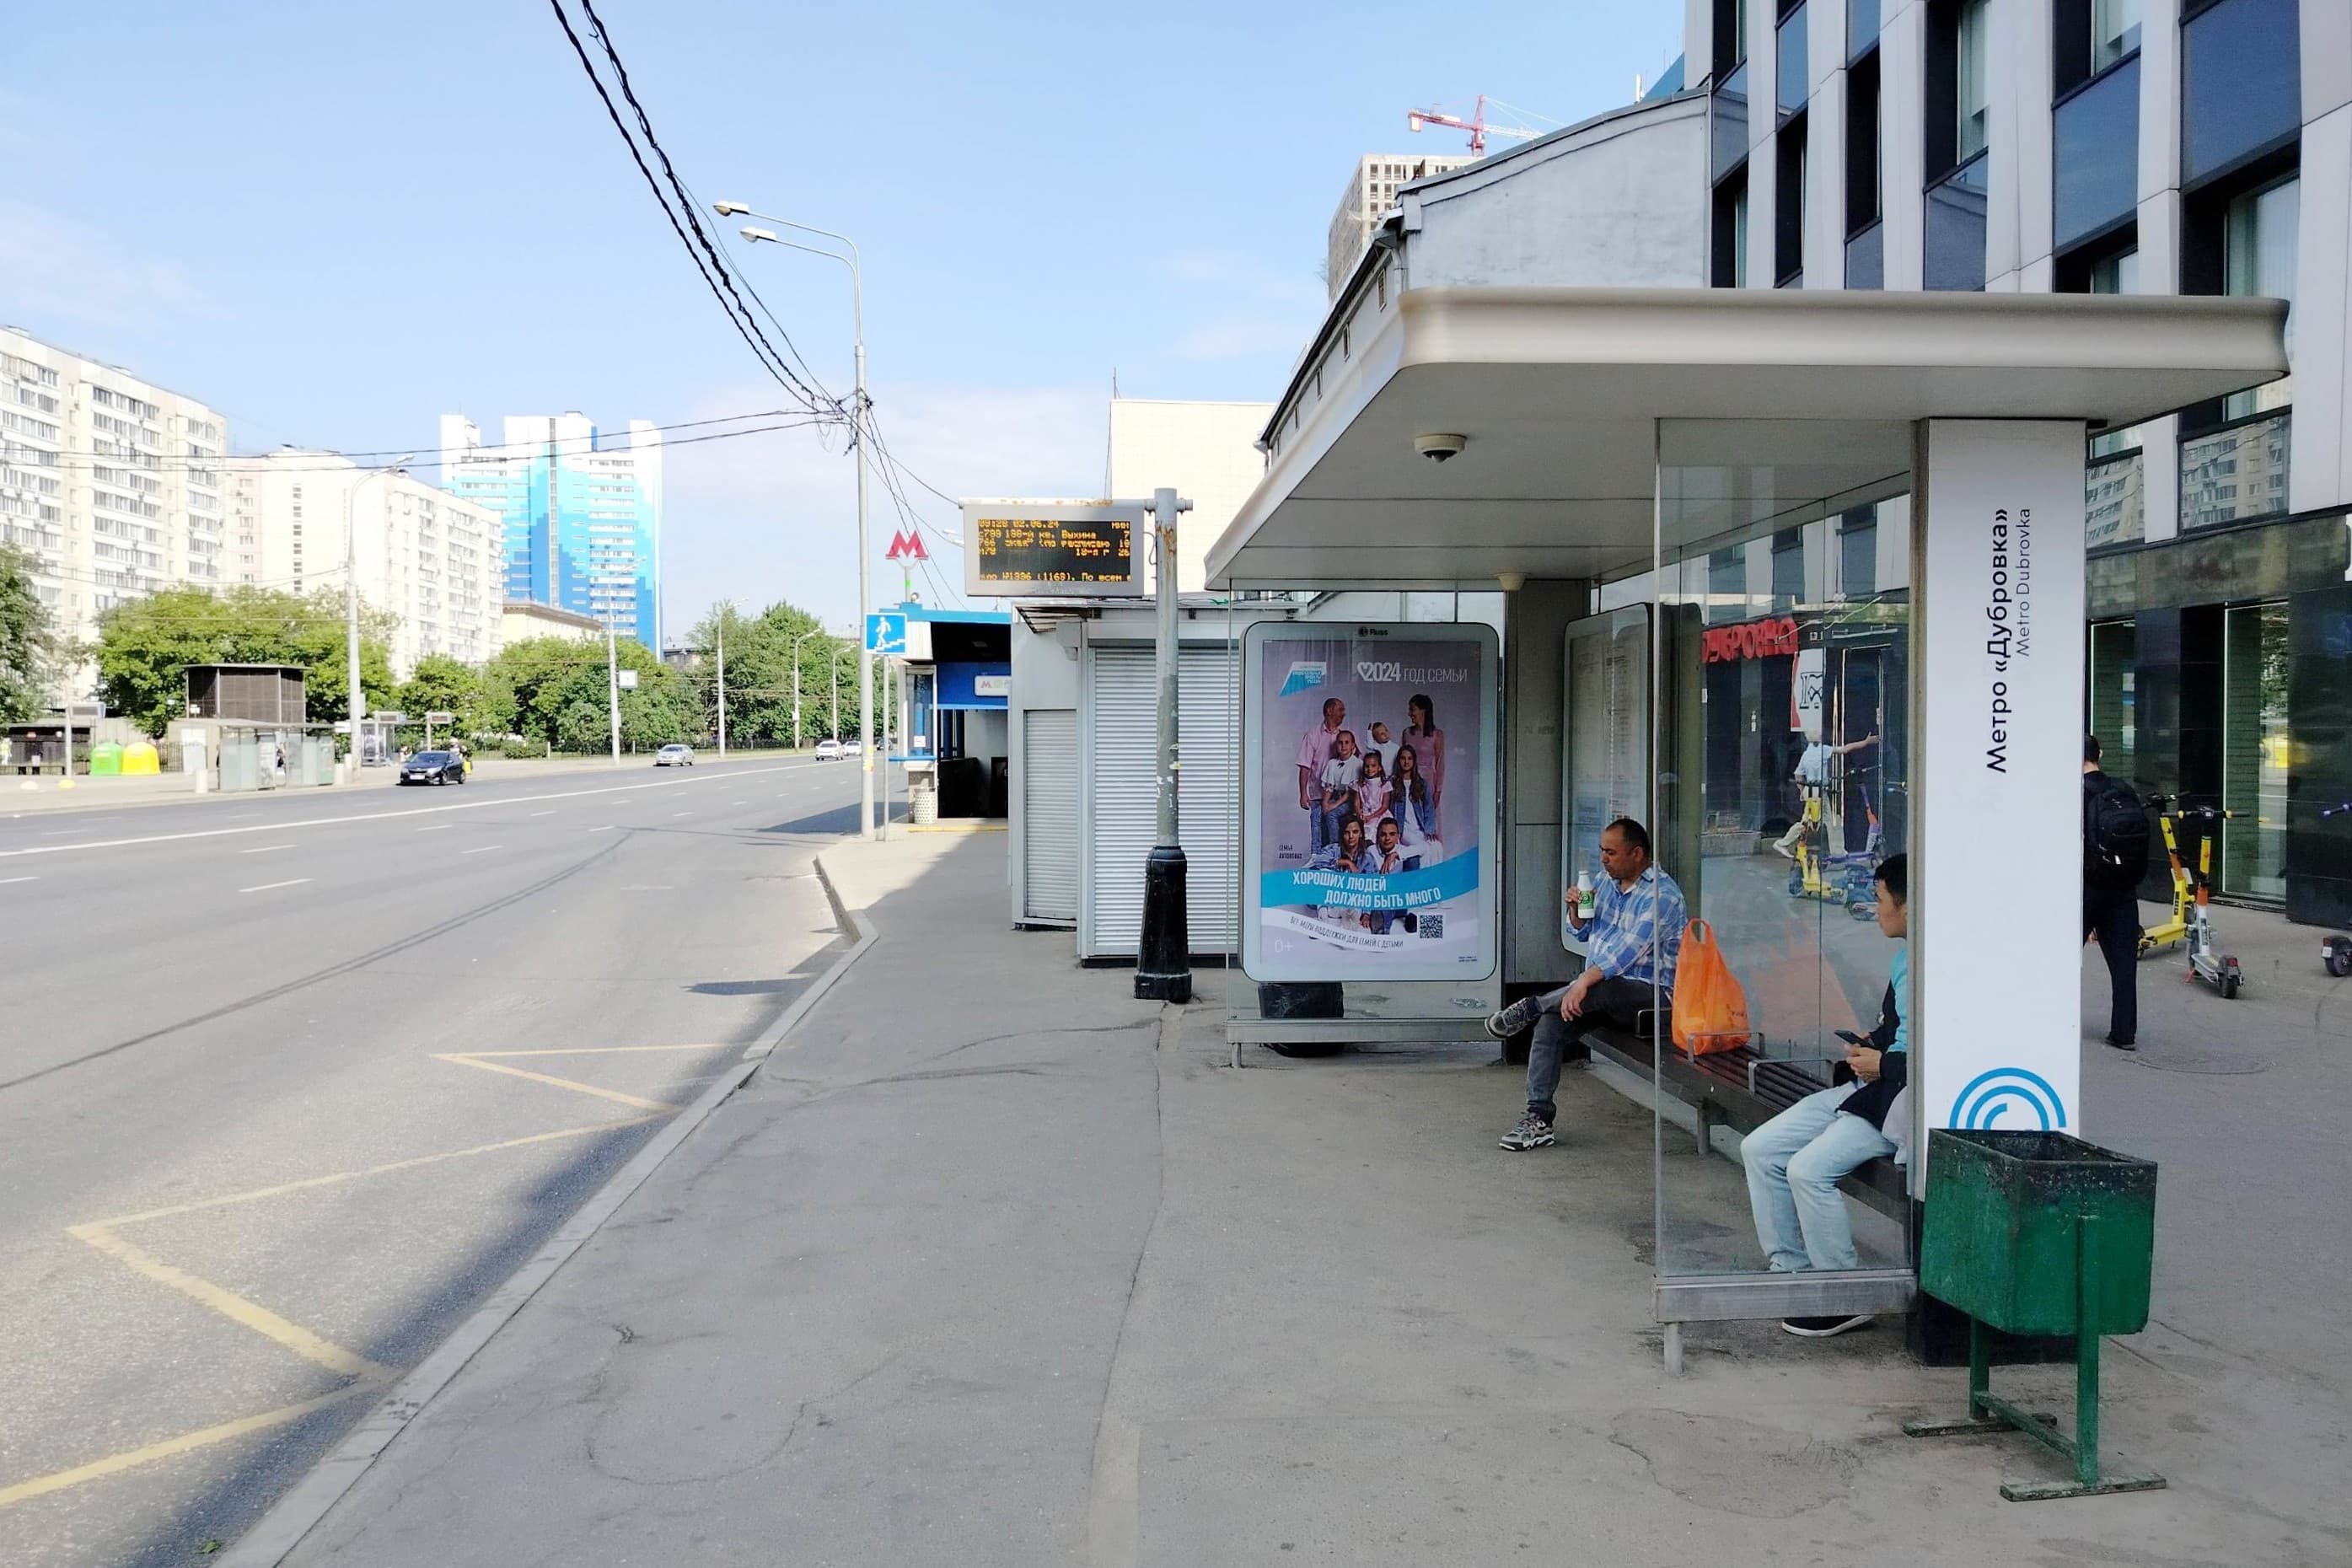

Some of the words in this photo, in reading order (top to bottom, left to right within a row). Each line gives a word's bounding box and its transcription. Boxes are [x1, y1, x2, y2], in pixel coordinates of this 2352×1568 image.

[1123, 530, 1130, 539] 7
[2016, 508, 2031, 594] Dubrovka
[1986, 508, 2012, 673] «Дубровка»
[2016, 601, 2031, 657] Metro
[1357, 662, 1401, 682] 2024
[1986, 681, 2012, 774] Метро
[1293, 872, 1345, 889] ХОРОШИХ
[1346, 875, 1387, 893] ЛЮДЕЙ
[1324, 889, 1372, 908] ДОЛЖНО
[1373, 894, 1404, 908] БЫТЬ
[1405, 887, 1442, 906] МНОГО
[1314, 926, 1347, 941] ПОДДЕРЖКИ
[1346, 934, 1359, 943] ДЛЯ
[1359, 937, 1377, 947] СЕМЕЙ
[1381, 940, 1404, 949] ДЕТЬМИ
